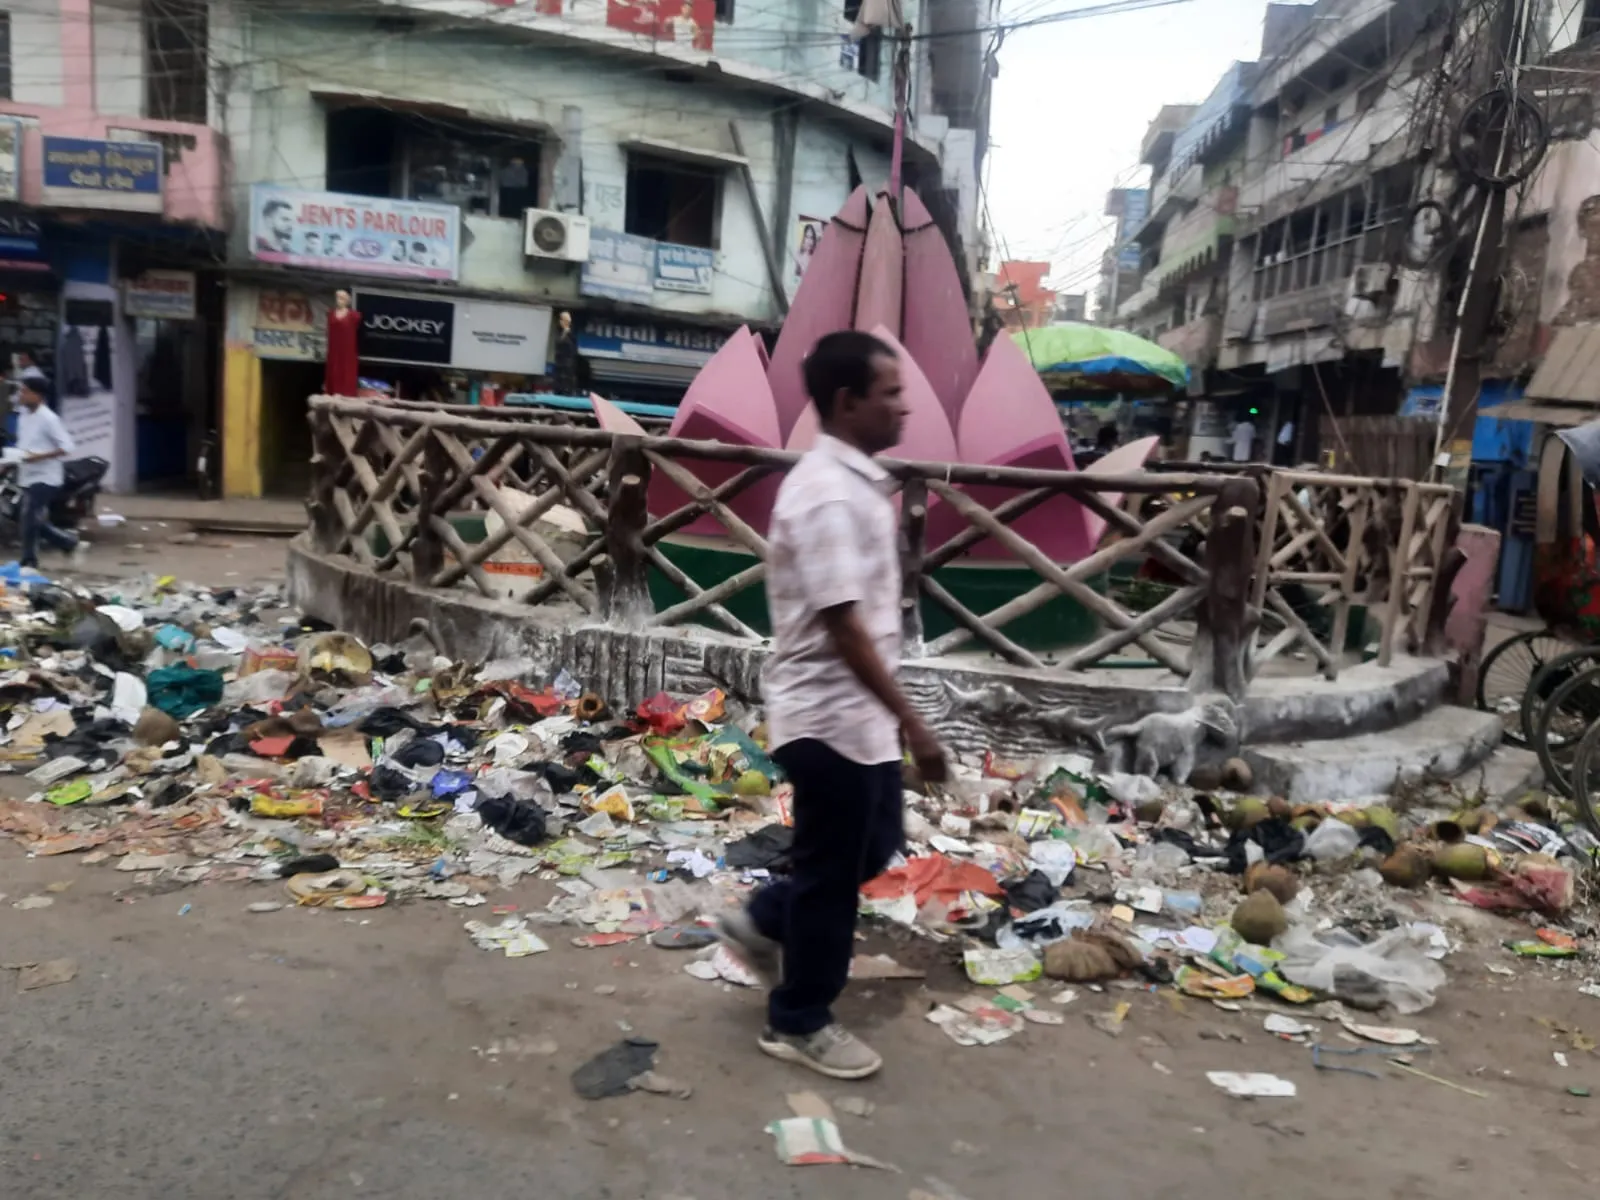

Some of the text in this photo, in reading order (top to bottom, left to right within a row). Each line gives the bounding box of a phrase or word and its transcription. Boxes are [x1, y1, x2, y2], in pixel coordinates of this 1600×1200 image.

[297, 204, 446, 239] JENTS PARLOUR
[364, 313, 446, 335] JOCKEY
